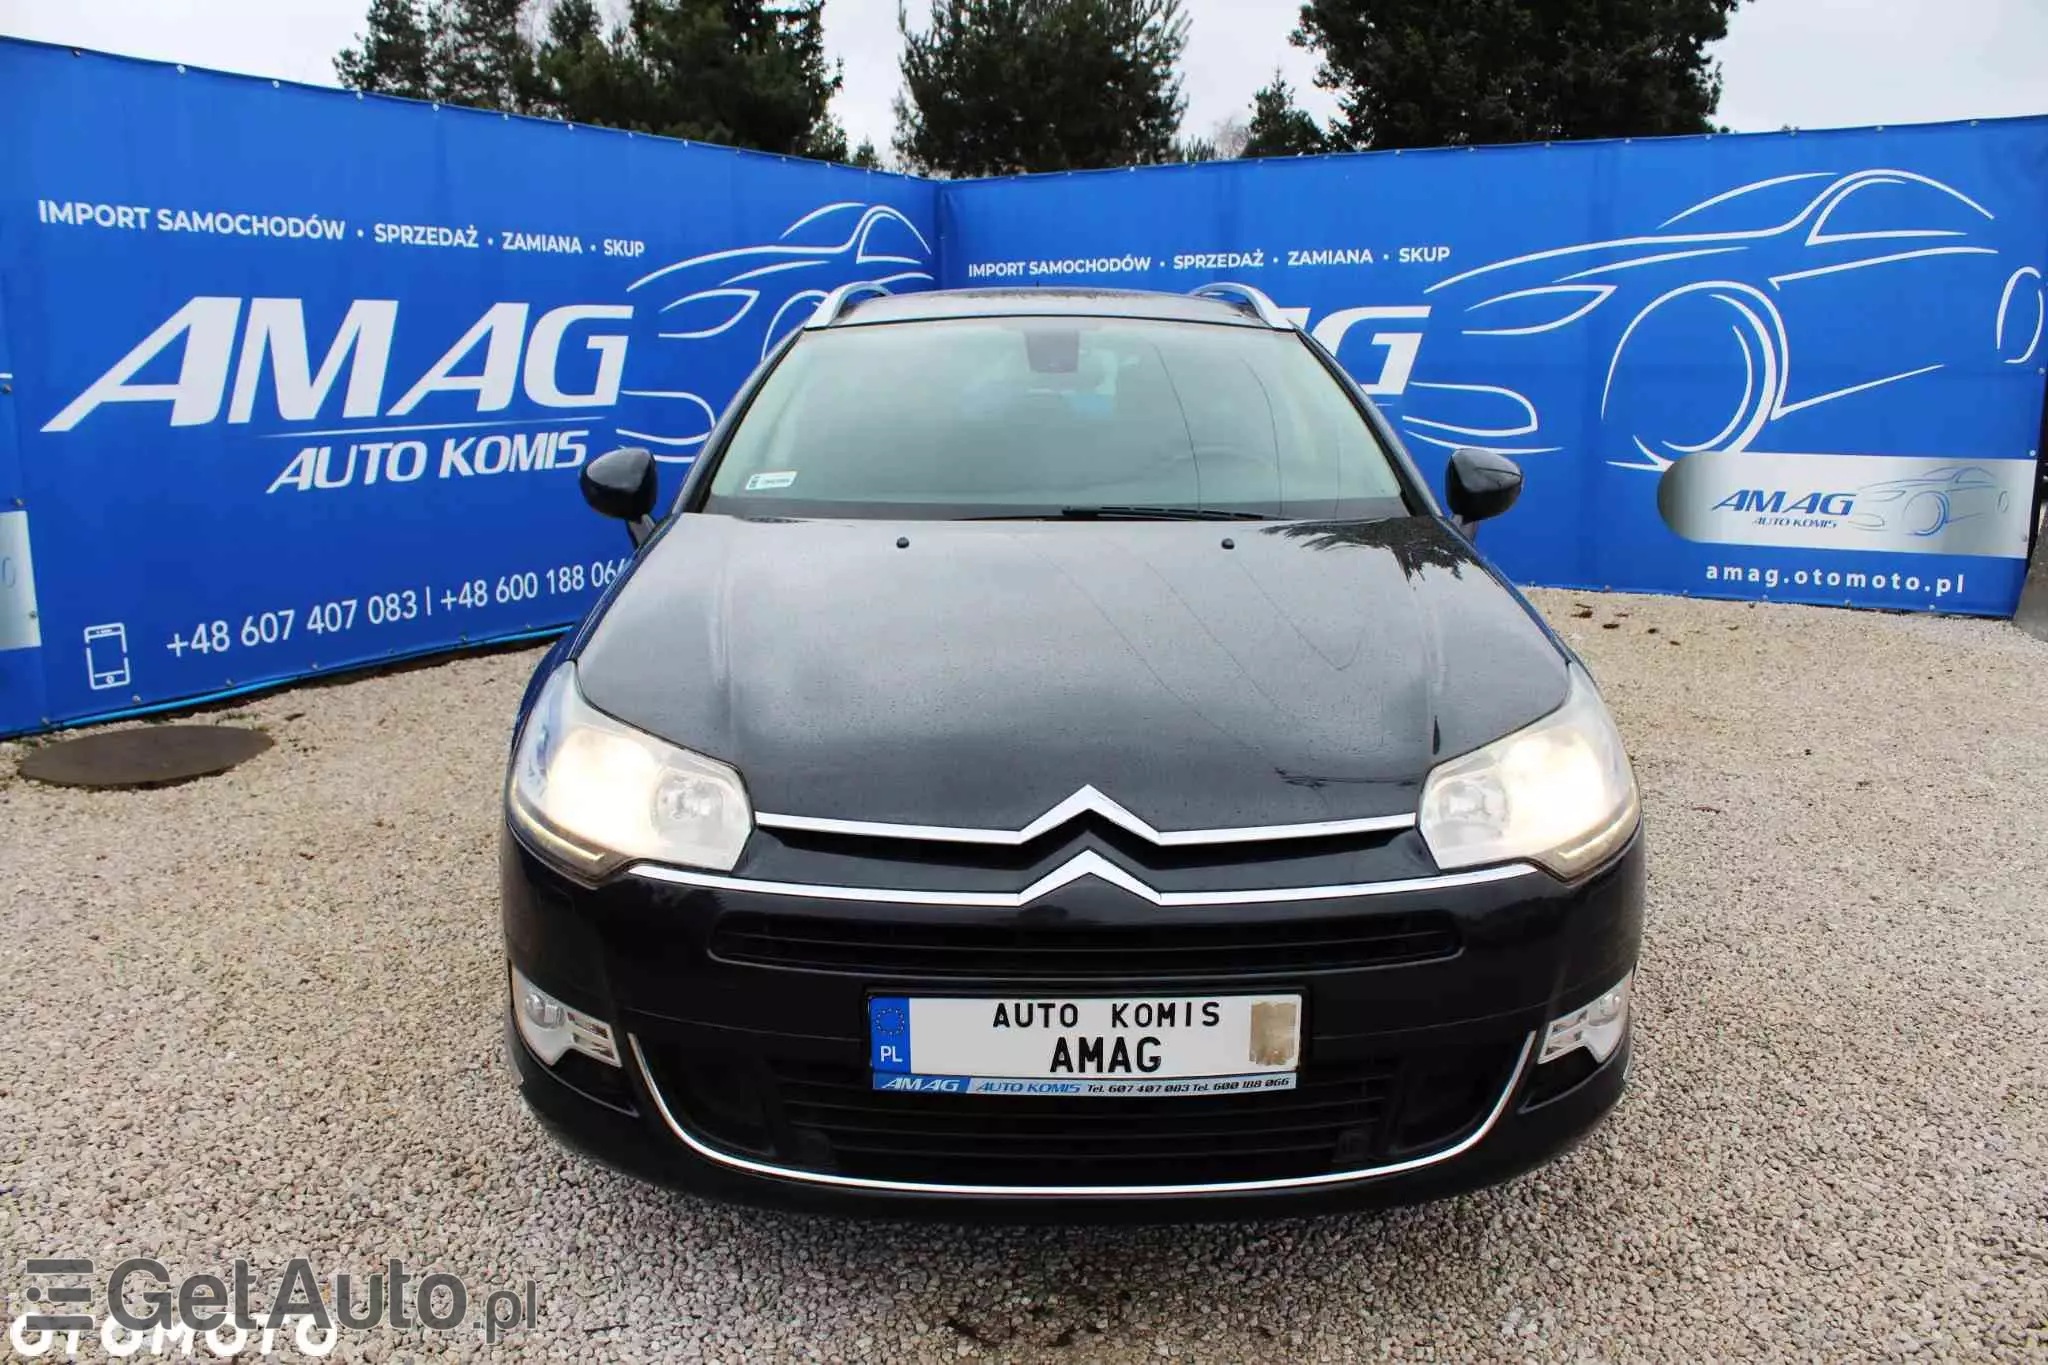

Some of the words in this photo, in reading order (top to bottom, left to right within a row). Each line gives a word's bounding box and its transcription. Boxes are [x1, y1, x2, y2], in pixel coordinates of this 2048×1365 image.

[38, 199, 151, 230] IMPORT
[157, 208, 346, 241] SAMOCHODÓW
[373, 223, 479, 248] SPRZEDAŻ
[502, 232, 583, 254] ZAMIANA
[603, 238, 645, 257] SKUP
[968, 261, 1024, 277] IMPORT
[1028, 254, 1151, 275] SAMOCHODÓW
[1173, 248, 1264, 269] SPRZEDAŻ
[1287, 249, 1373, 266] ZAMIANA
[1399, 246, 1450, 263] SKUP
[40, 296, 634, 432] AMAG
[265, 440, 428, 494] AUTO
[438, 429, 589, 479] KOMIS
[1711, 489, 1857, 516] AMAG
[1706, 564, 1964, 597] amag.otomoto.pl
[166, 622, 231, 659] +48
[240, 609, 296, 647] 607
[306, 599, 358, 635] 407
[367, 591, 417, 625] 083
[440, 580, 488, 612] +48
[495, 572, 538, 604] 600
[545, 565, 584, 594] 188
[992, 1001, 1079, 1029] AUTO
[1111, 1001, 1221, 1028] KOMIS
[880, 1045, 904, 1063] PL
[1049, 1036, 1162, 1074] AMAG
[881, 1077, 960, 1092] AMAG
[976, 1082, 1022, 1093] AUTO
[1027, 1083, 1081, 1093] KOMIS
[1108, 1085, 1134, 1093] 607
